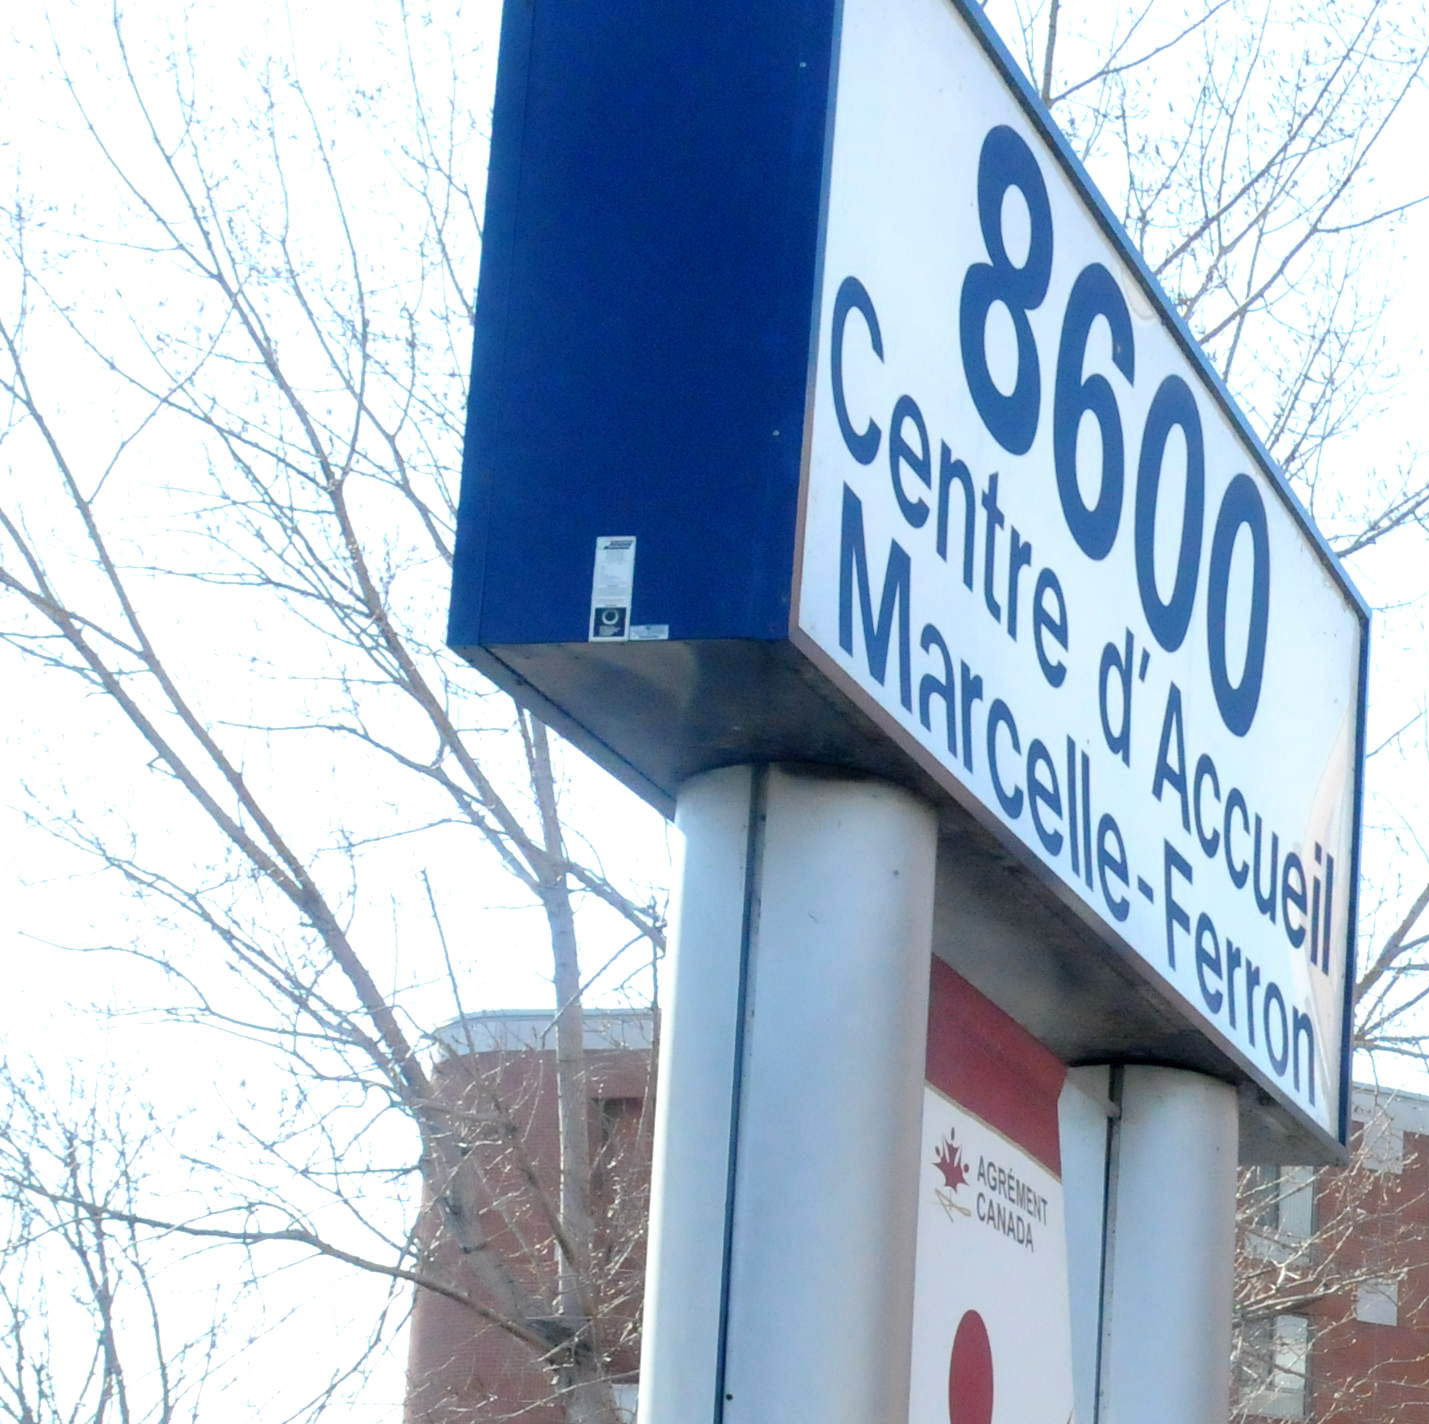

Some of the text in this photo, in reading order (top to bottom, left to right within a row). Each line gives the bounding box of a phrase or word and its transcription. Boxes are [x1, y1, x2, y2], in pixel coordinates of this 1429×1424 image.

[830, 275, 1334, 976] Centre d'Accueil
[958, 124, 1271, 738] 8600
[837, 481, 1316, 1107] Marcelle-Ferron
[975, 1191, 1035, 1252] CANADA
[976, 1154, 1048, 1226] AGRÉMENT
